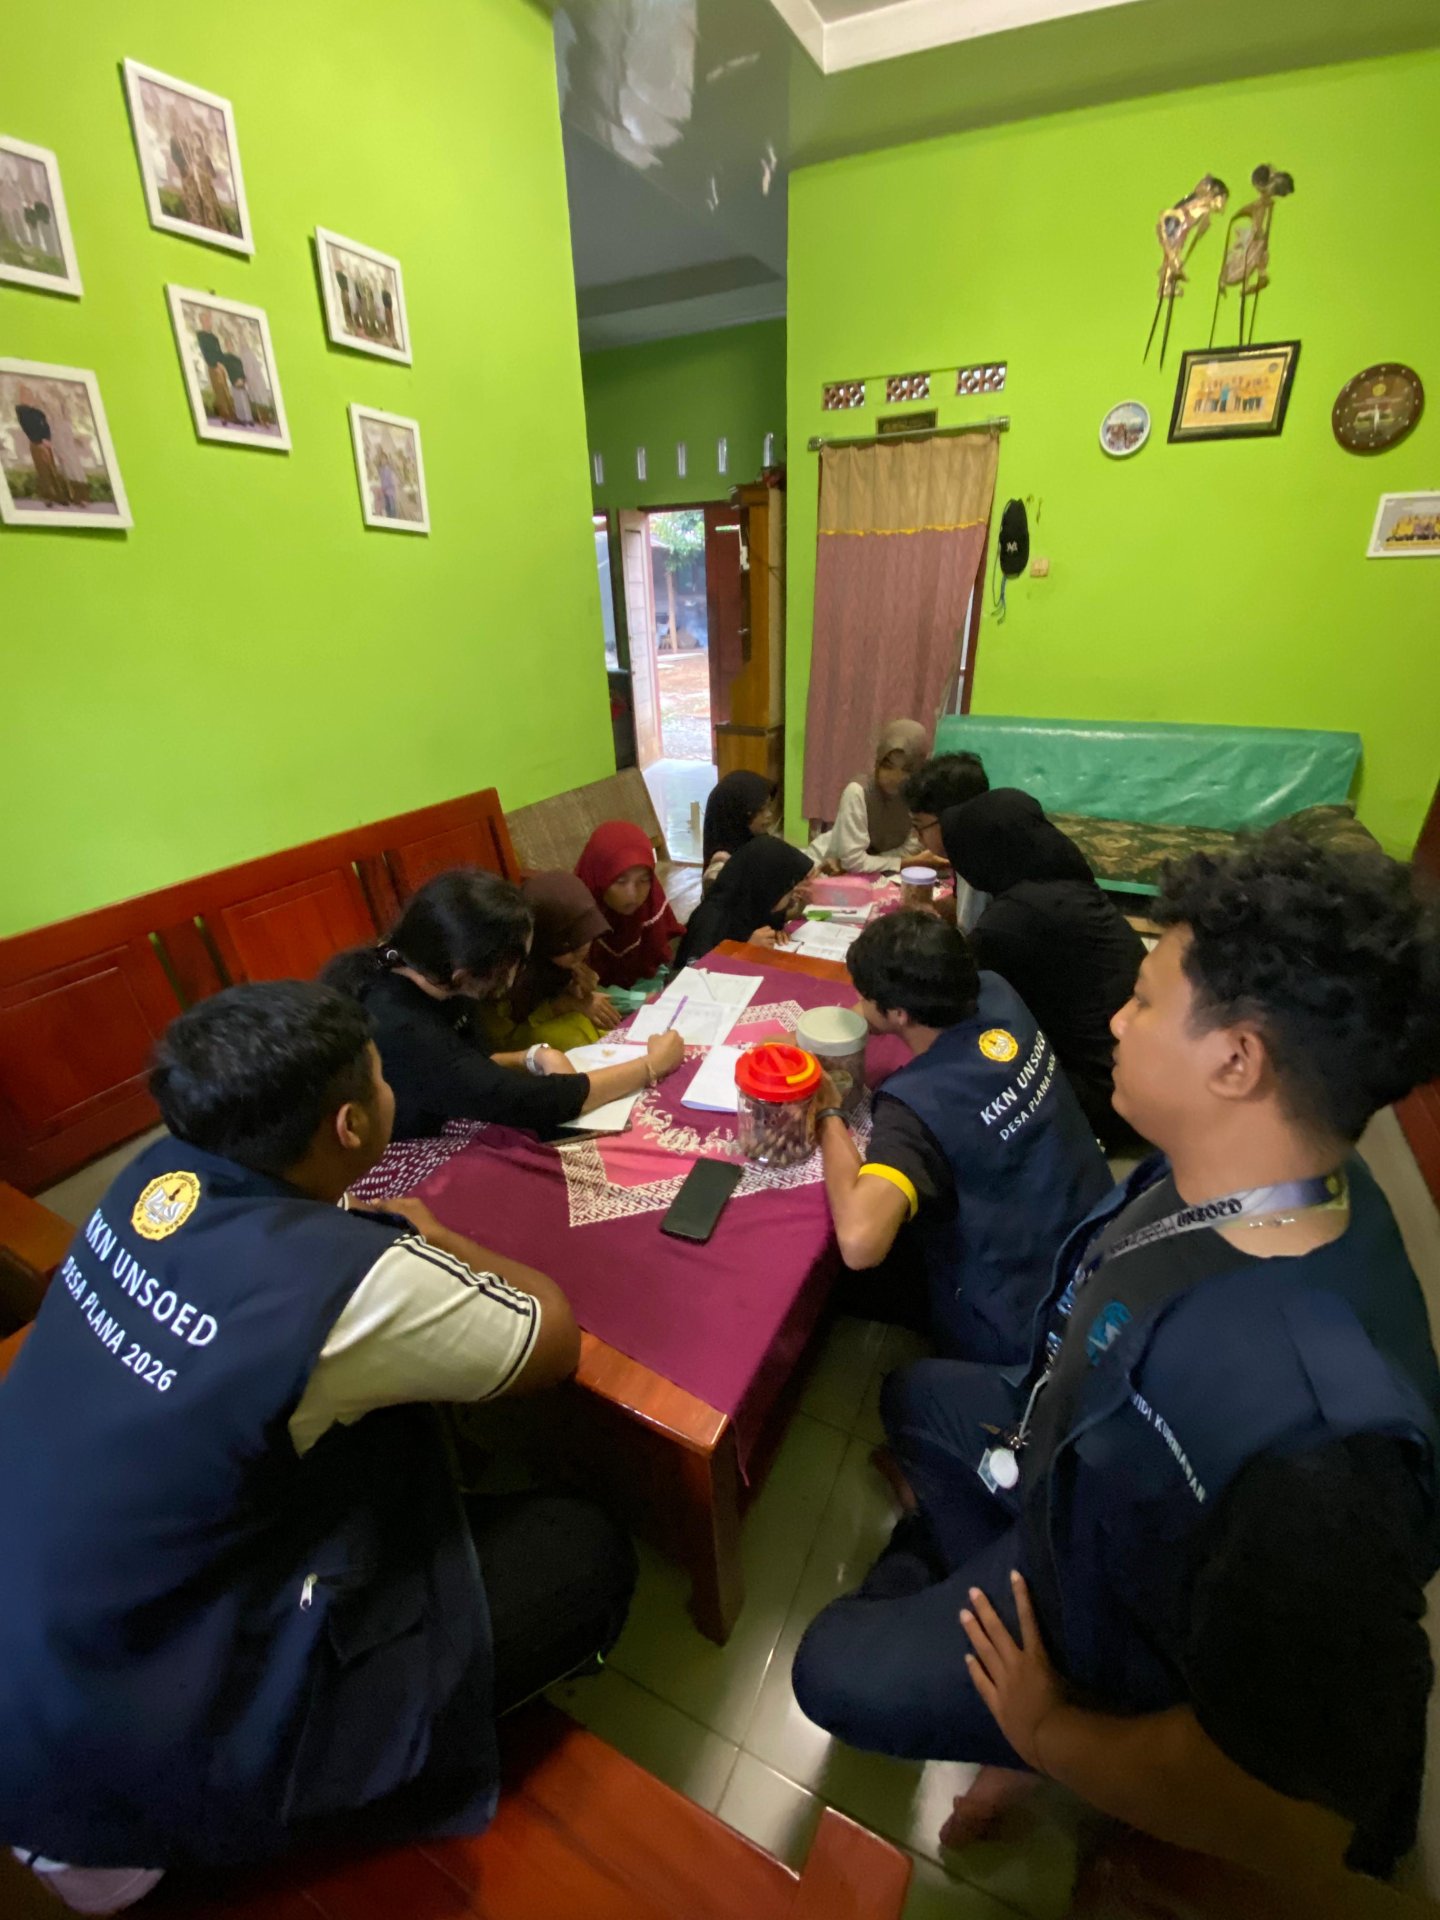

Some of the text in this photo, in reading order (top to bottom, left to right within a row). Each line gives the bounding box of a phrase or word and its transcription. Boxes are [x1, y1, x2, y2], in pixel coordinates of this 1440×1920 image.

[981, 1087, 1018, 1125] KKN
[1017, 1030, 1046, 1089] UNSOED
[1000, 1111, 1029, 1140] DESA
[1028, 1075, 1051, 1112] PLANA
[62, 1255, 178, 1391] DESA PLANA 2026
[86, 1208, 118, 1261] KKN
[112, 1247, 218, 1346] UNSOED
